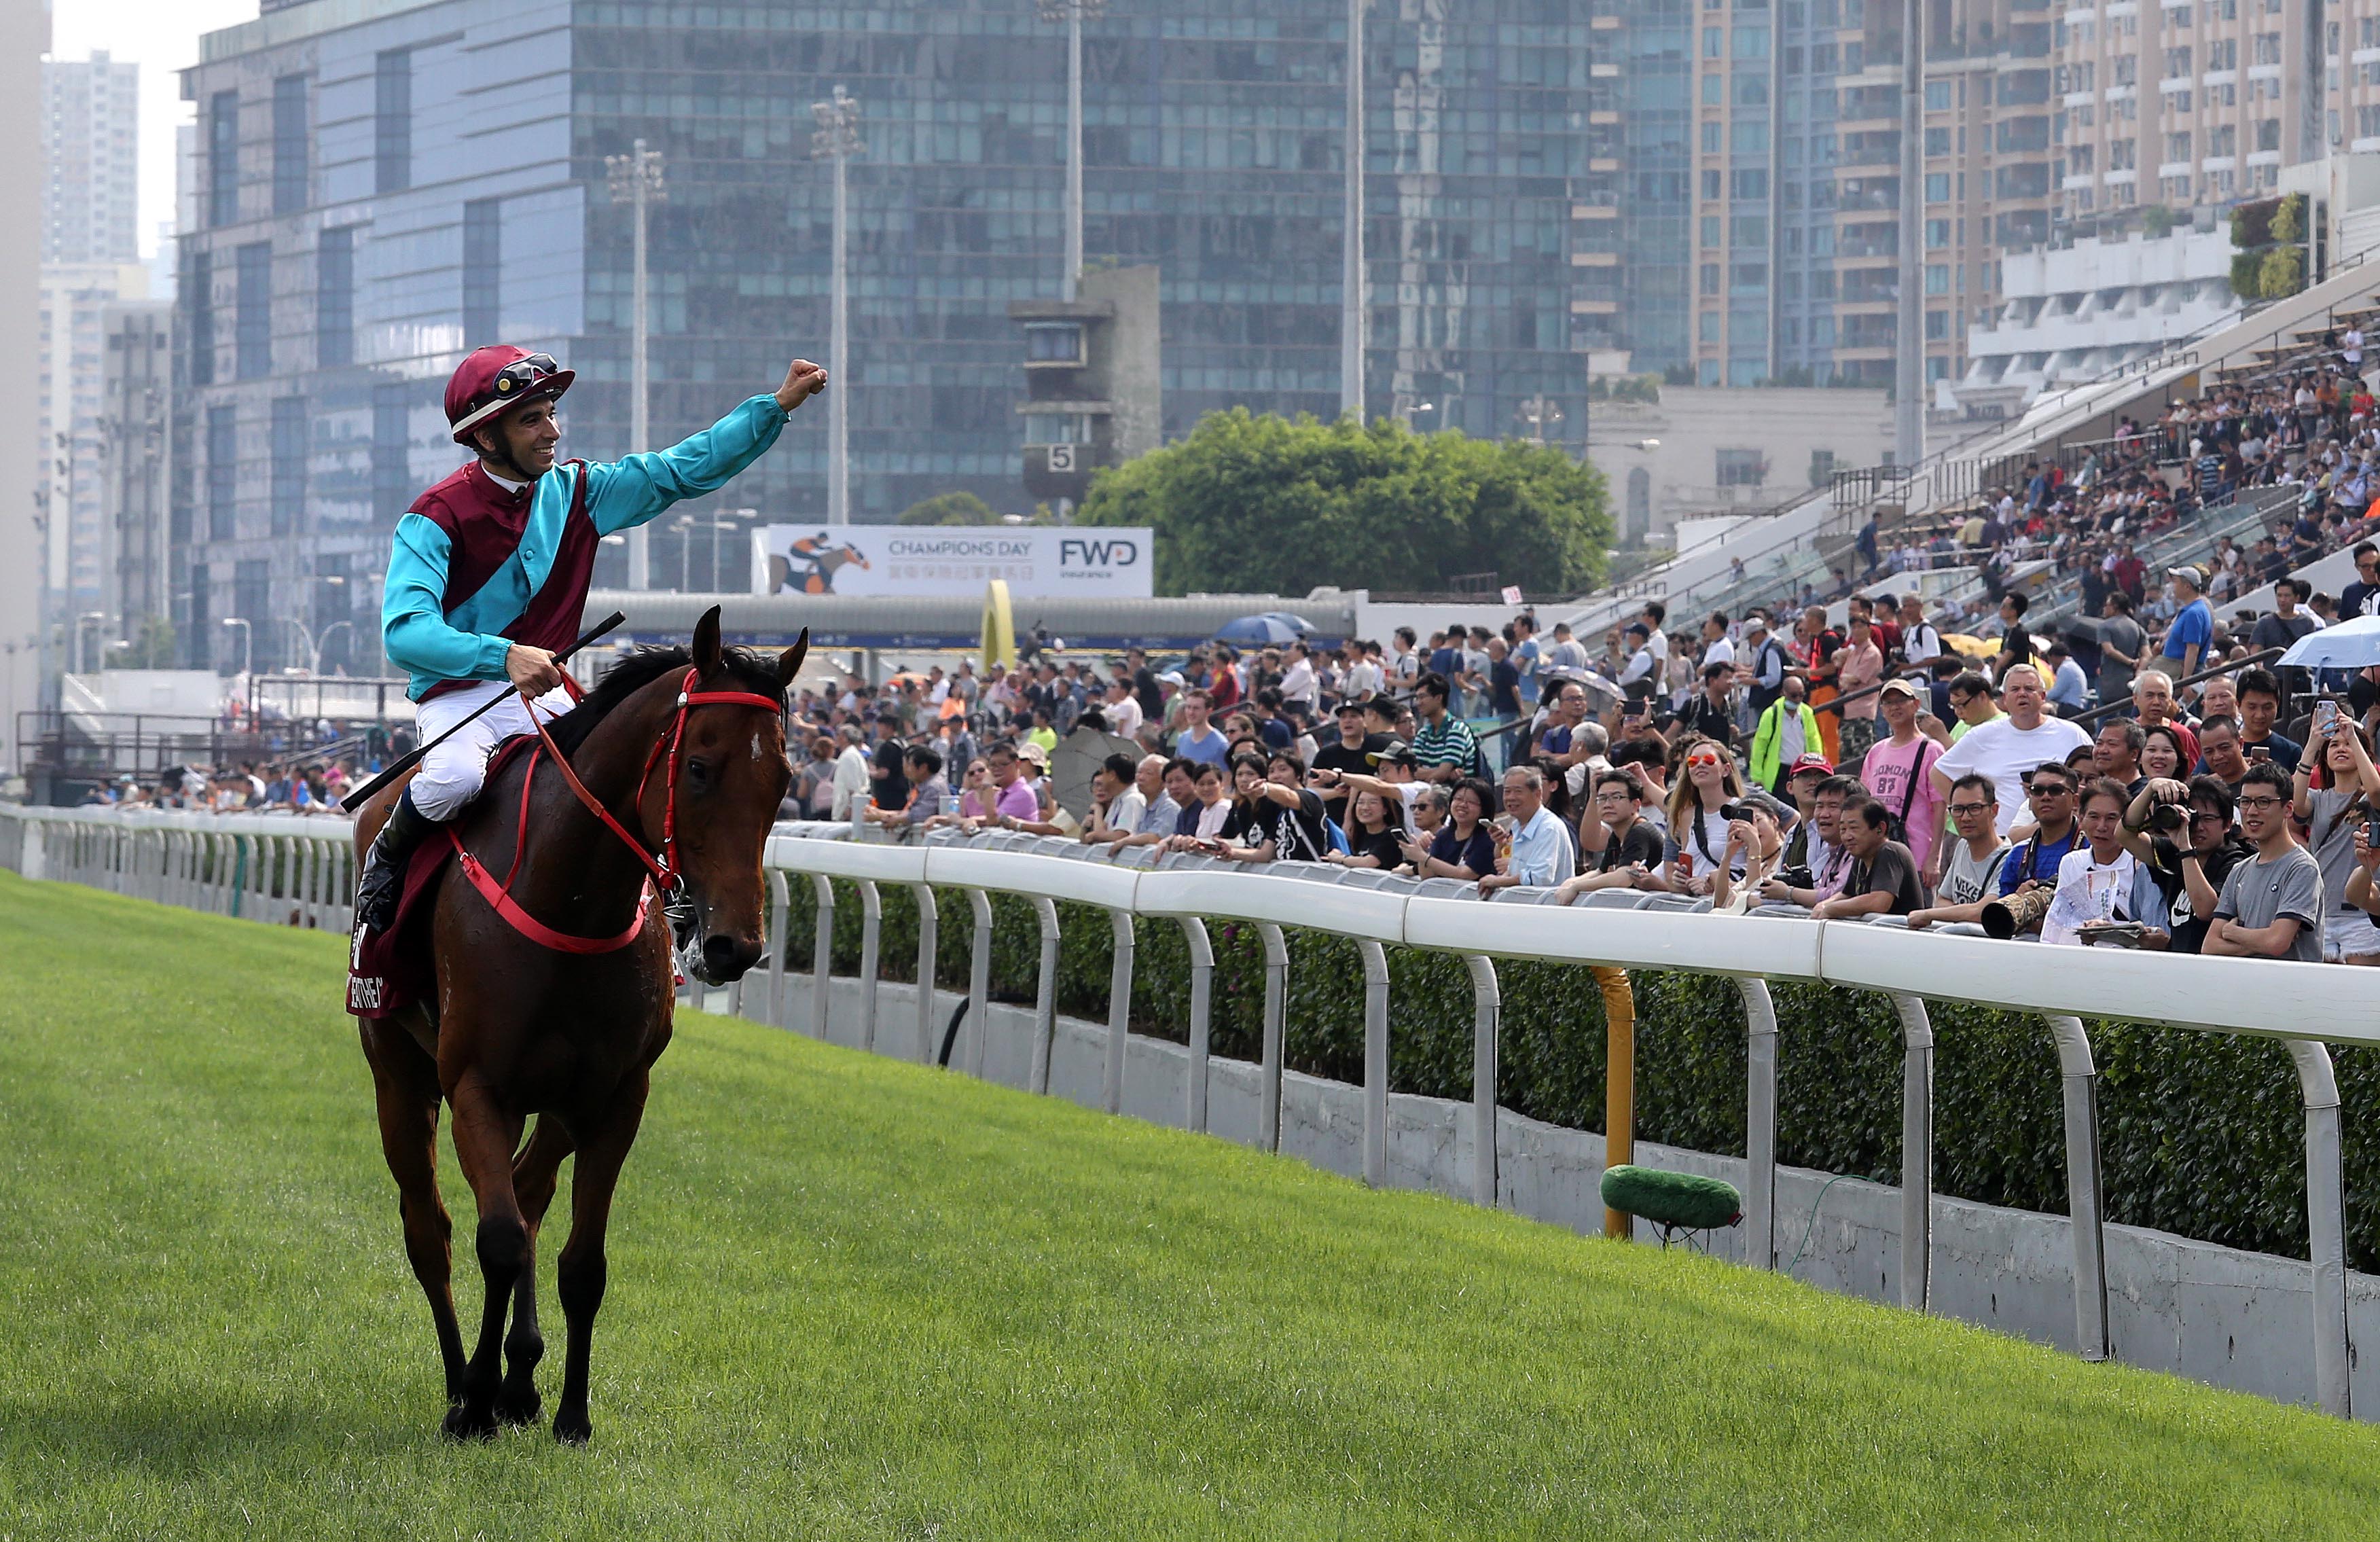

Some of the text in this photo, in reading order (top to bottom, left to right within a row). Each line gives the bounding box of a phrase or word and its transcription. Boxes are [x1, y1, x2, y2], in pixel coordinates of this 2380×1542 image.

[1052, 446, 1070, 468] 5
[888, 540, 1032, 556] CHAMPIONS DAY
[1060, 540, 1137, 566] FWD
